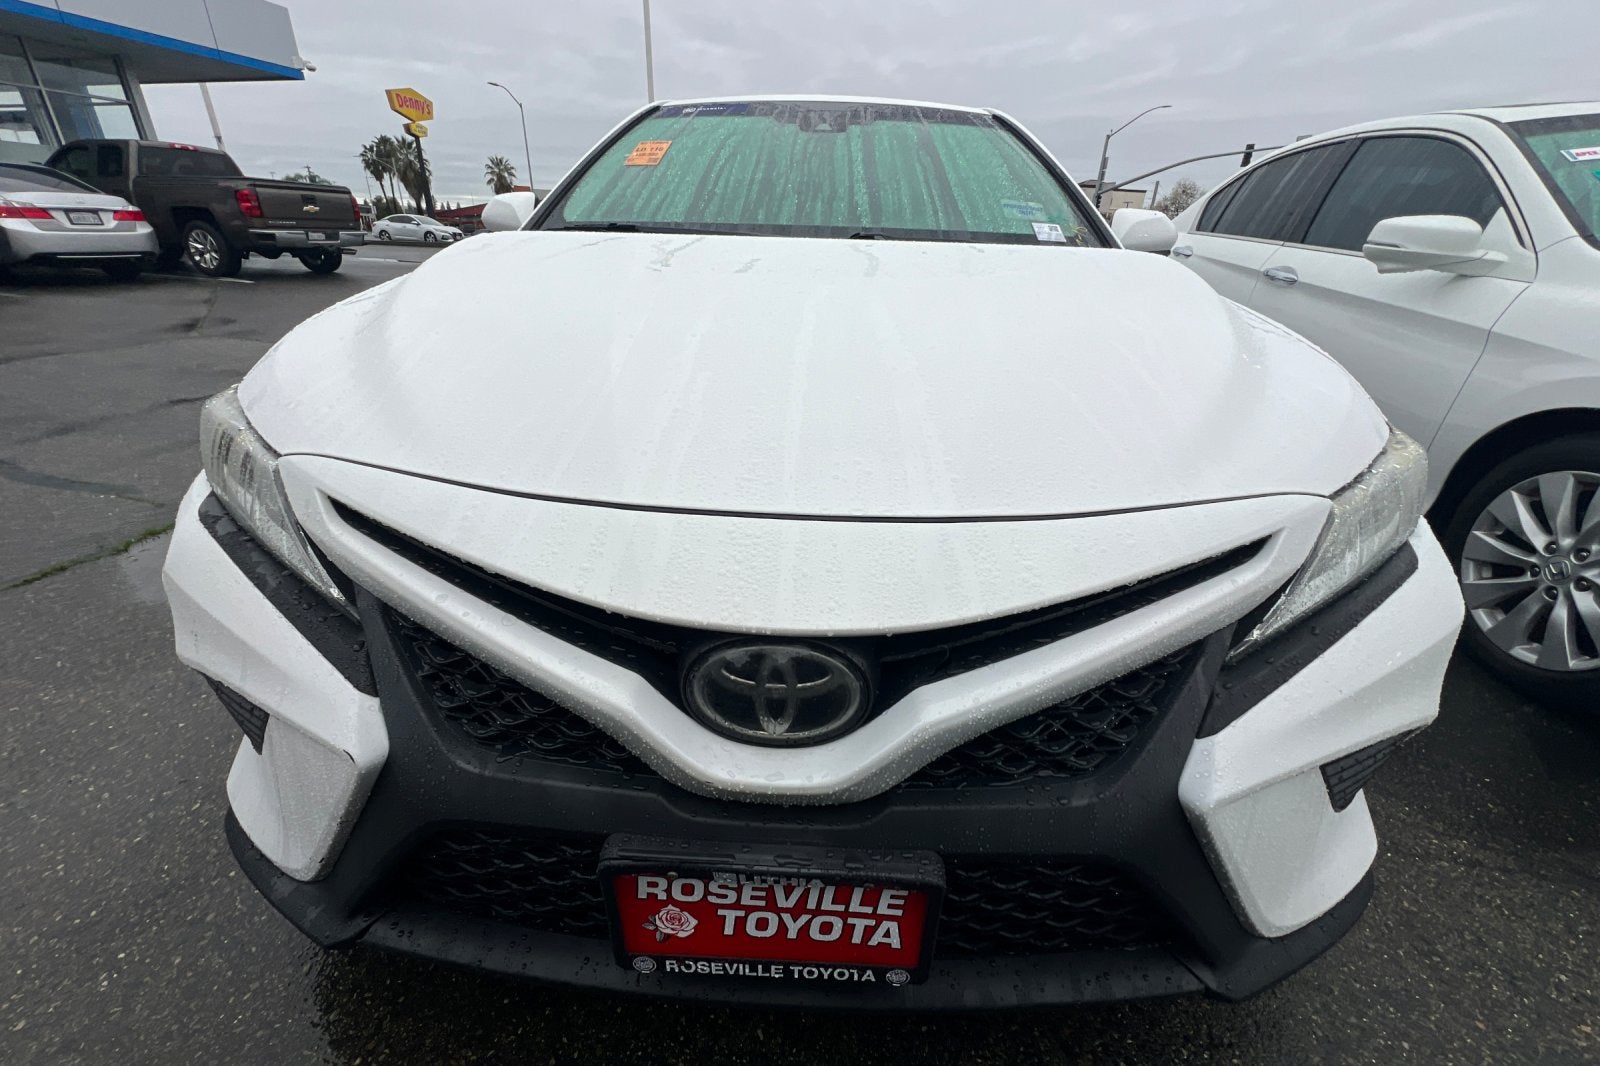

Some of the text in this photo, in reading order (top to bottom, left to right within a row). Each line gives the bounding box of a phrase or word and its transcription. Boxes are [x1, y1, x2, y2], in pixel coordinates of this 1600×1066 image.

[396, 93, 431, 115] Denny's
[638, 876, 907, 915] ROSEVILLE
[718, 910, 902, 949] TOYOTA
[665, 959, 784, 978] ROSEVILLE
[789, 964, 876, 982] TOYOTA
